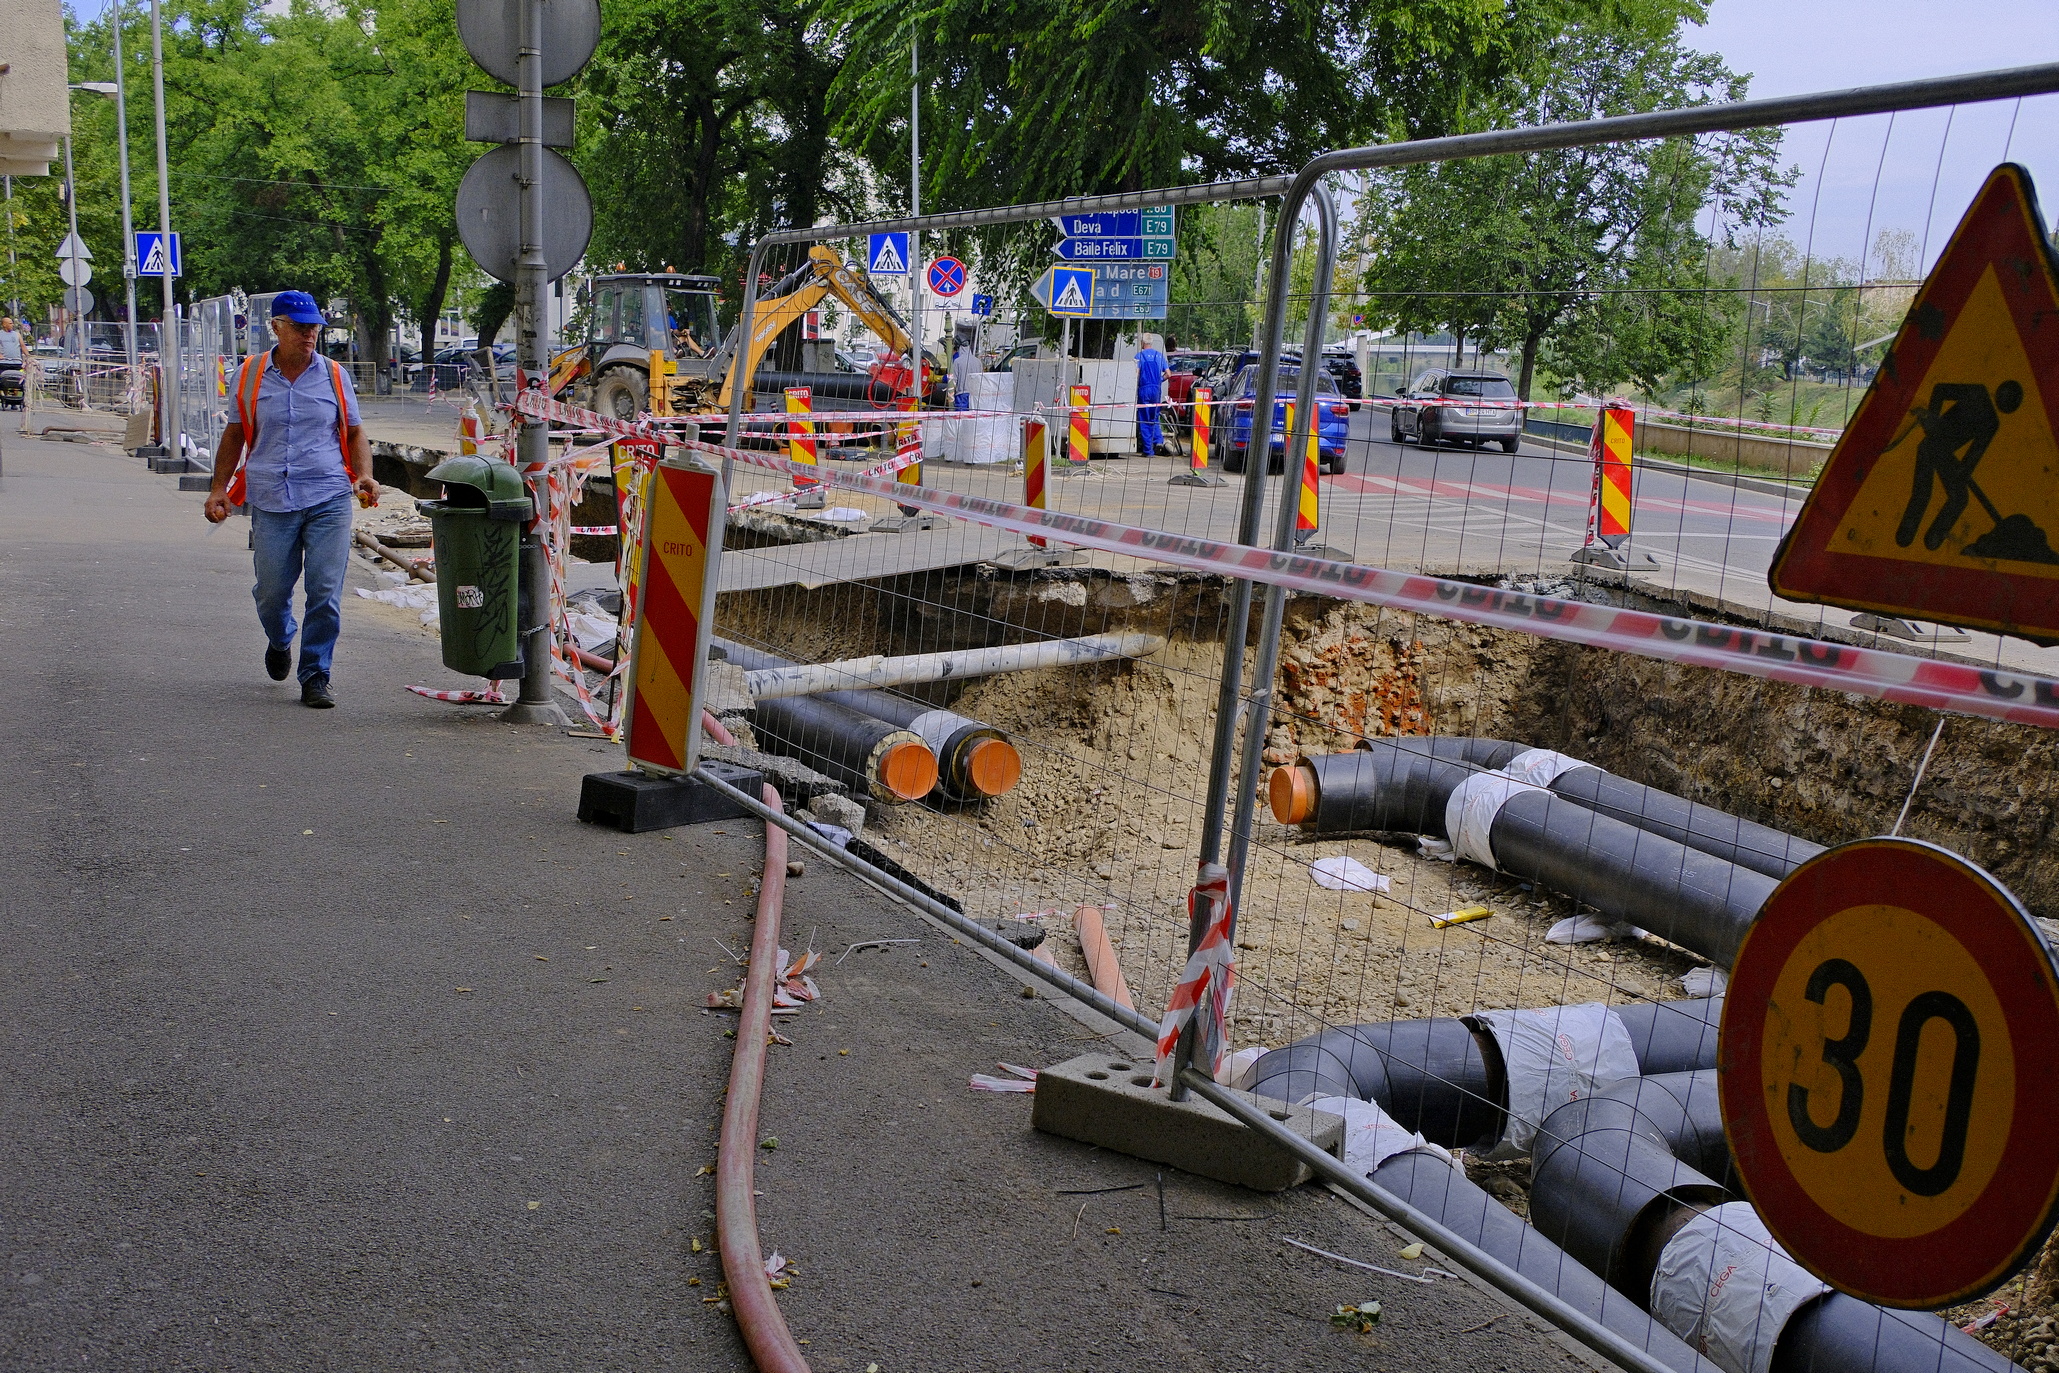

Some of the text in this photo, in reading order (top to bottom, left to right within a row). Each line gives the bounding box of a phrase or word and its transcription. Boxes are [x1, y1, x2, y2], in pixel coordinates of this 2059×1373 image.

[1074, 220, 1102, 234] Deva
[1102, 242, 1128, 256] Felix
[1106, 266, 1146, 280] Mare
[1151, 268, 1160, 278] 19
[835, 270, 874, 314] CASE
[664, 542, 692, 556] CRITO
[1558, 1034, 1573, 1060] CEGA
[1787, 958, 1981, 1197] 30
[1710, 1265, 1737, 1298] CEGA
